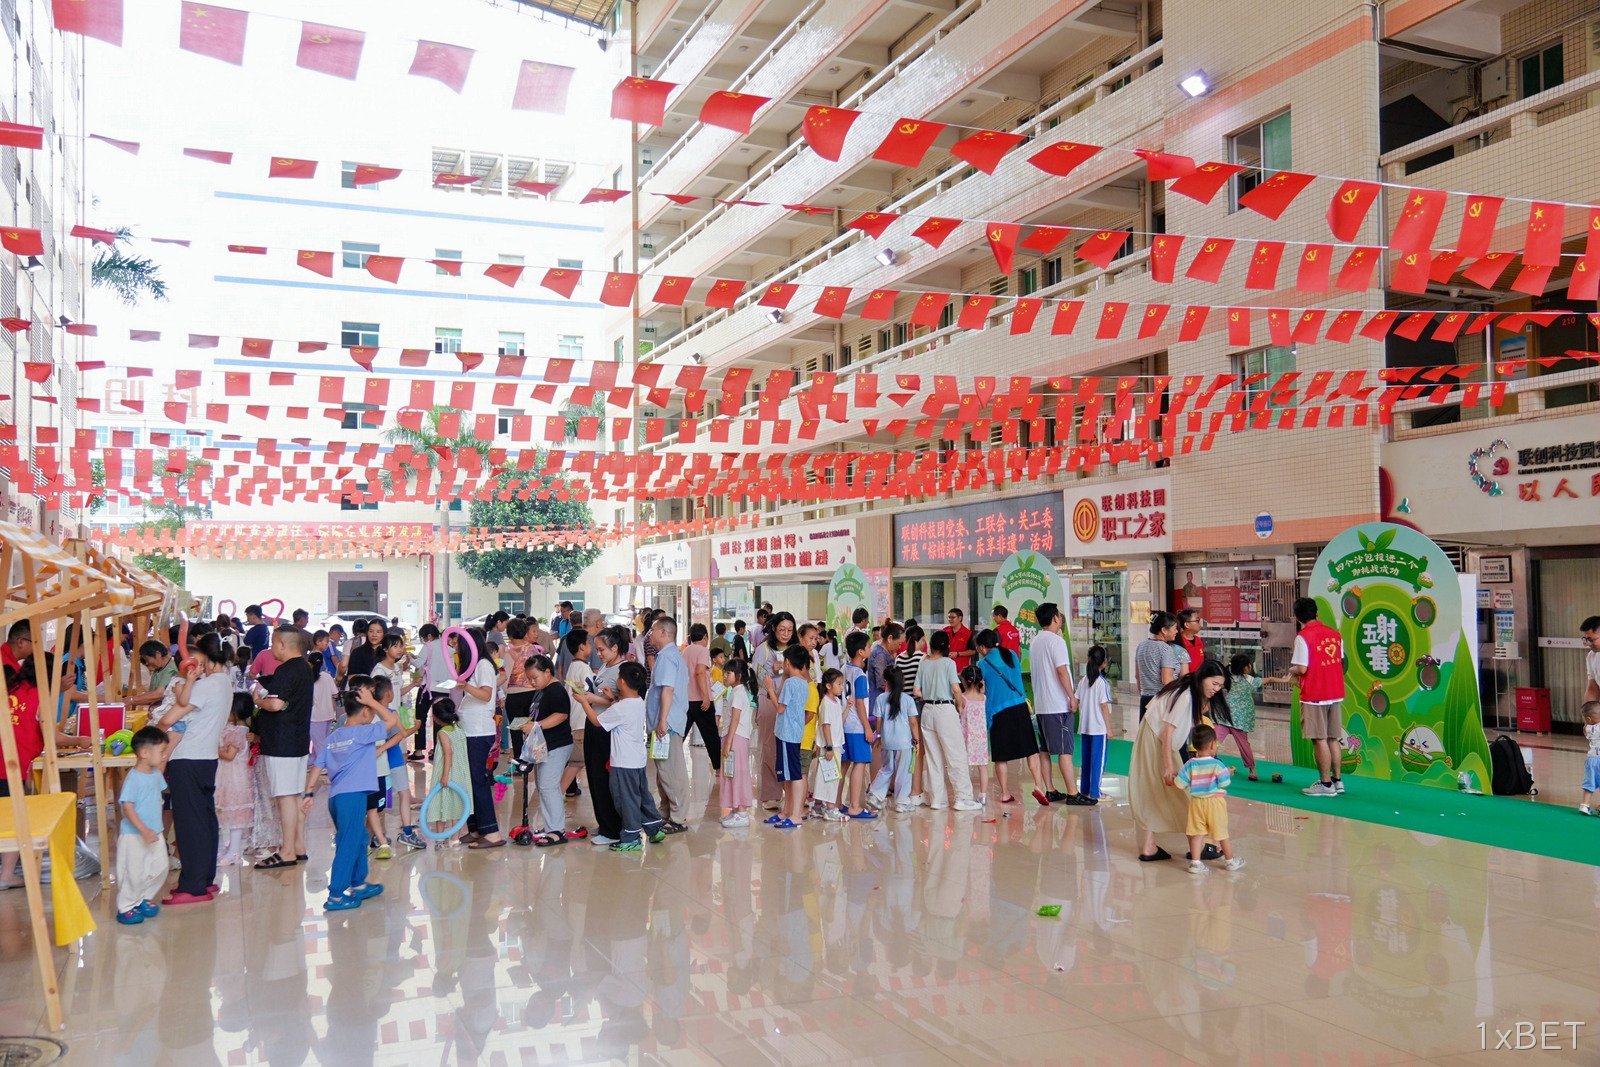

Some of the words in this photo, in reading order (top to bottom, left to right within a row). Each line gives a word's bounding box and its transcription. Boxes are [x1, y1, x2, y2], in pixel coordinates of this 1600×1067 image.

[1101, 488, 1166, 512] 联创科技园
[1101, 511, 1166, 541] 职工之家
[1335, 552, 1419, 573] 四个沙包投进二个
